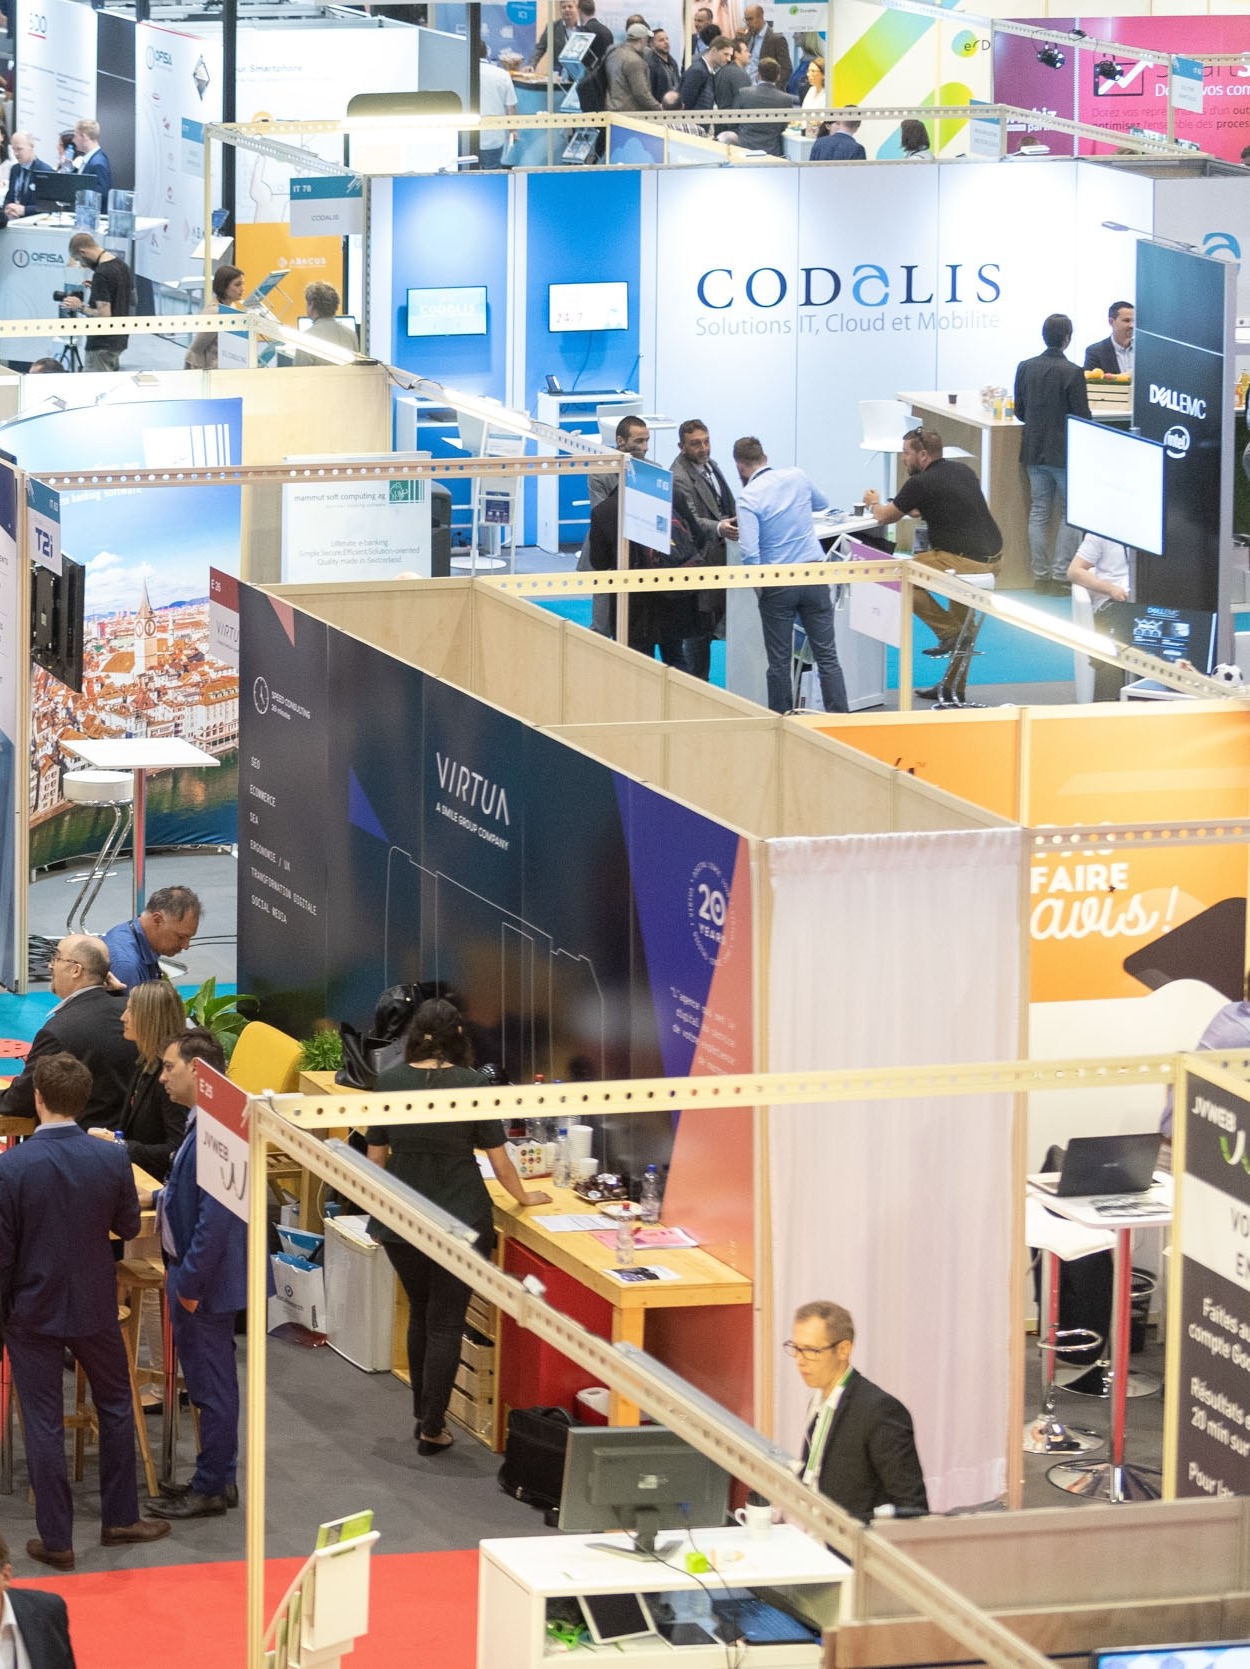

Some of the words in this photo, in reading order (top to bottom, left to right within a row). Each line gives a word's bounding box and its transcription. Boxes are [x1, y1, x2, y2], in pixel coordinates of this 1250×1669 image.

[292, 184, 300, 193] IT
[31, 252, 65, 264] OFISA
[289, 257, 327, 266] ABACUS
[695, 315, 793, 336] Solutions
[825, 311, 886, 333] Cloud
[891, 315, 911, 331] et
[294, 494, 325, 502] mammut
[326, 493, 339, 501] soft
[340, 492, 376, 503] computing
[34, 527, 54, 559] T2i
[285, 697, 311, 720] CONSULTING
[250, 755, 261, 770] SEO
[250, 784, 276, 808] ECOMMERCE
[250, 811, 260, 826] SEA
[458, 815, 478, 833] GROUP
[477, 826, 510, 851] COMPANY
[250, 839, 277, 864] ERGONOMIE
[250, 866, 292, 901] TRANSFORMATION
[292, 892, 319, 917] DIGITALE
[1030, 862, 1129, 895] FAIRE
[250, 893, 271, 915] SOCIAL
[271, 905, 288, 925] MEDIA
[697, 883, 727, 927] 20
[697, 922, 727, 946] YEARS
[1191, 1095, 1237, 1133] JVWEB
[202, 1131, 229, 1162] JVWEB
[1202, 1297, 1239, 1335] Faites
[1188, 1322, 1231, 1359] compte
[1190, 1376, 1245, 1426] Résultats
[1191, 1406, 1207, 1431] 20
[1206, 1421, 1230, 1446] min
[1229, 1434, 1250, 1458] sur
[1188, 1461, 1216, 1495] Pour
